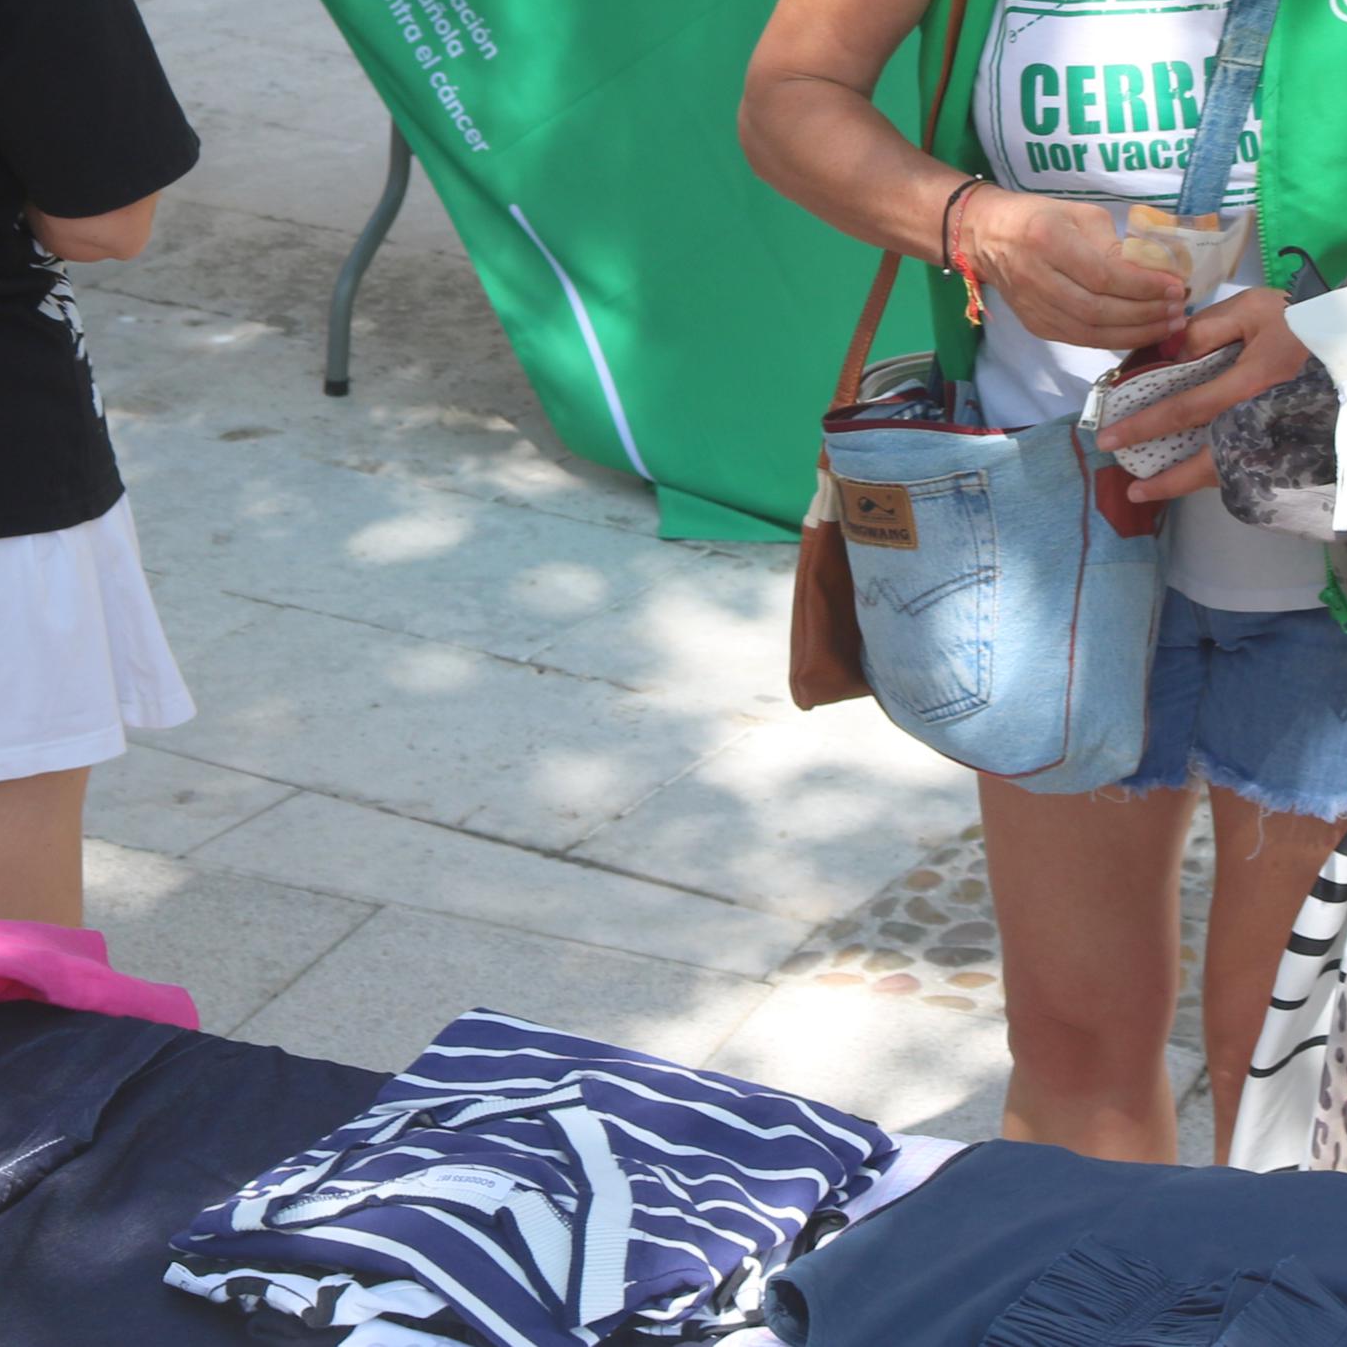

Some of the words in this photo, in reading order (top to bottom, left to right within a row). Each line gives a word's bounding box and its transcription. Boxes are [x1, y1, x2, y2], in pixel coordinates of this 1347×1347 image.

[415, 44, 442, 70] el
[429, 71, 490, 153] cáncer
[1025, 140, 1089, 173] por
